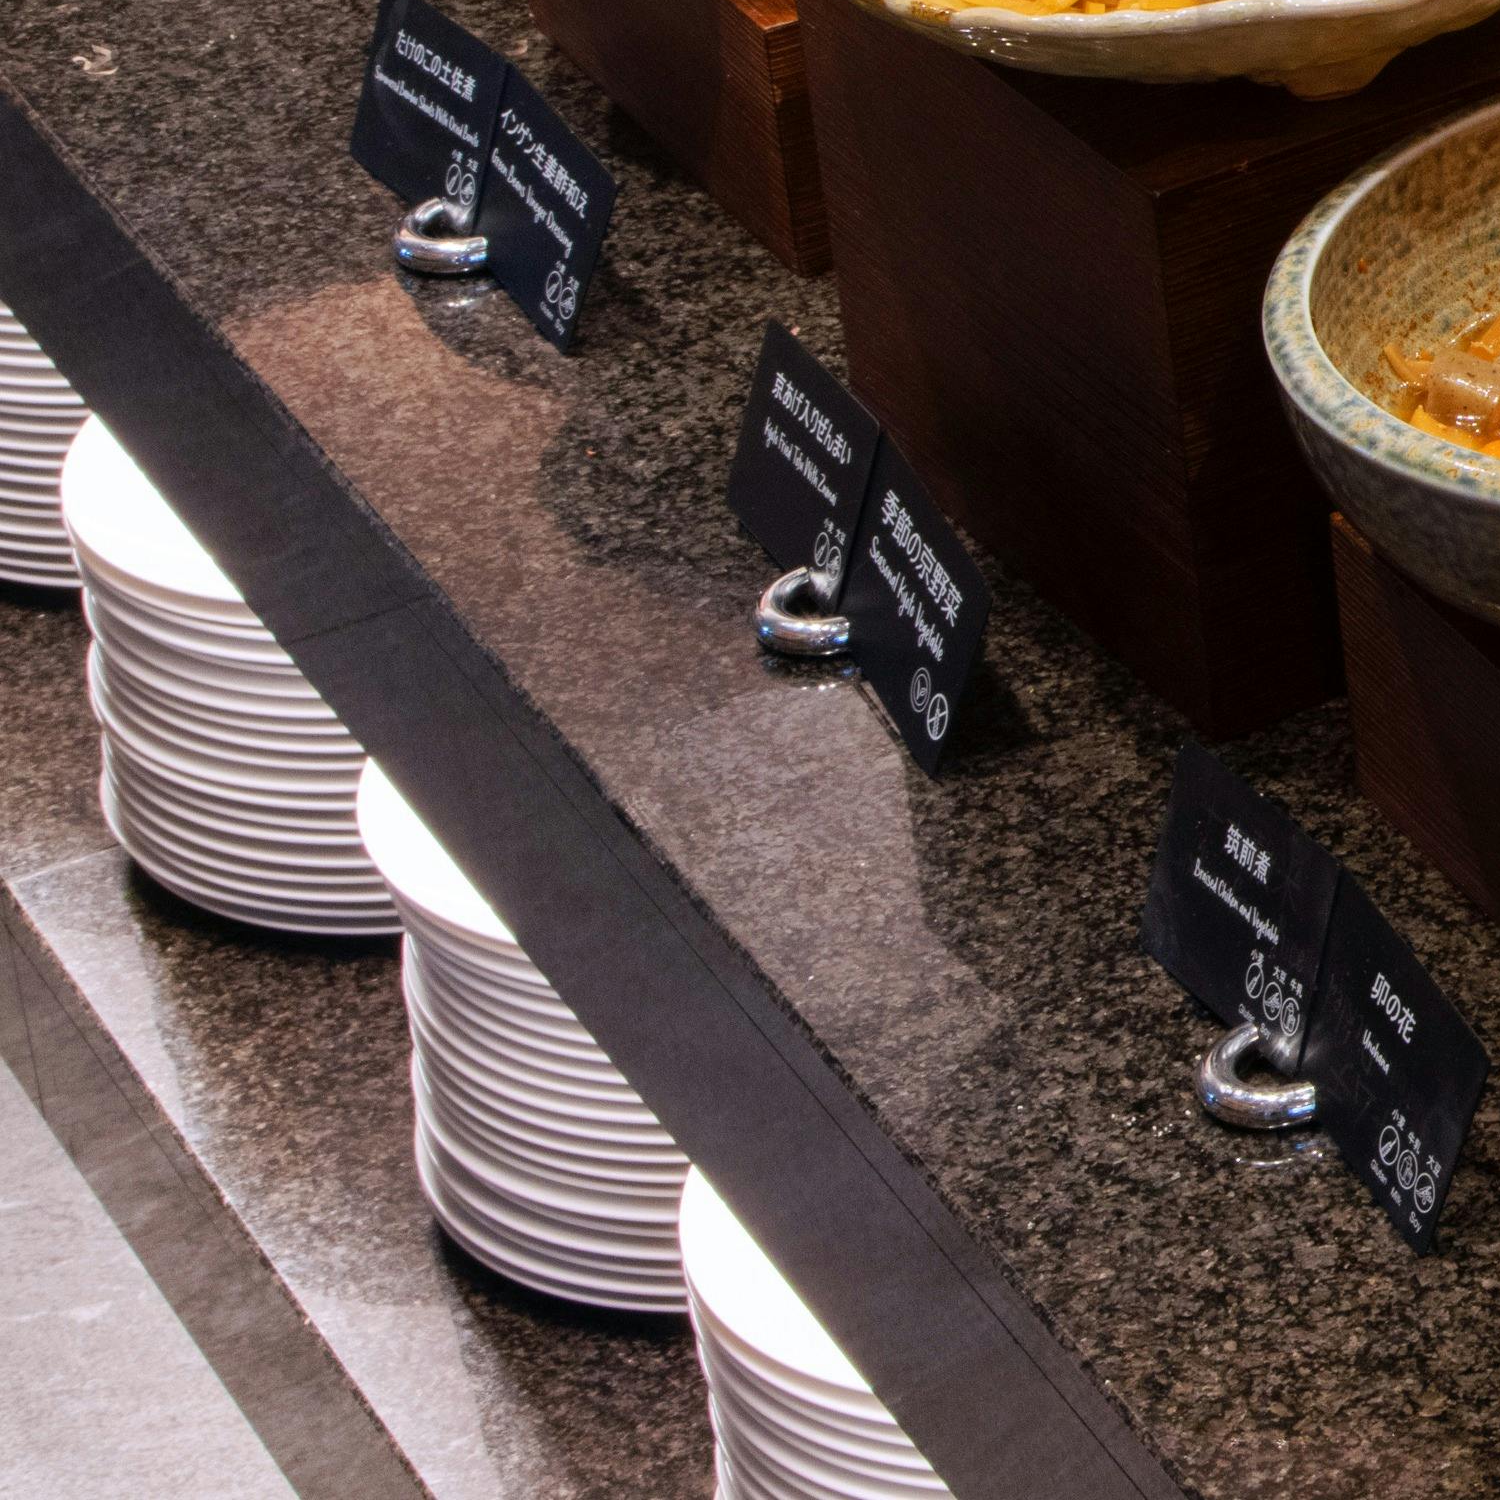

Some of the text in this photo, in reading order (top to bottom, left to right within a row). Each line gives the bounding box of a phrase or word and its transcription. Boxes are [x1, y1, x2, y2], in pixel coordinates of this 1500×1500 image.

[395, 28, 476, 103] たけのこの土佐煮
[500, 108, 588, 219] インゲン生姜酢和え
[771, 371, 852, 465] 京あげ入りぜんまい
[880, 489, 963, 628] 季節の京野菜
[869, 535, 944, 662] Seasonal Kyoto Vegetable
[1223, 823, 1271, 885] 筑前煮
[1193, 857, 1219, 894] Braised
[1238, 903, 1253, 923] and
[1251, 906, 1280, 946] Vegetable
[1370, 971, 1417, 1044] 卯の花
[1362, 1029, 1390, 1075] Unohana
[1425, 1154, 1442, 1178] 大豆
[1408, 1210, 1423, 1234] Soy
